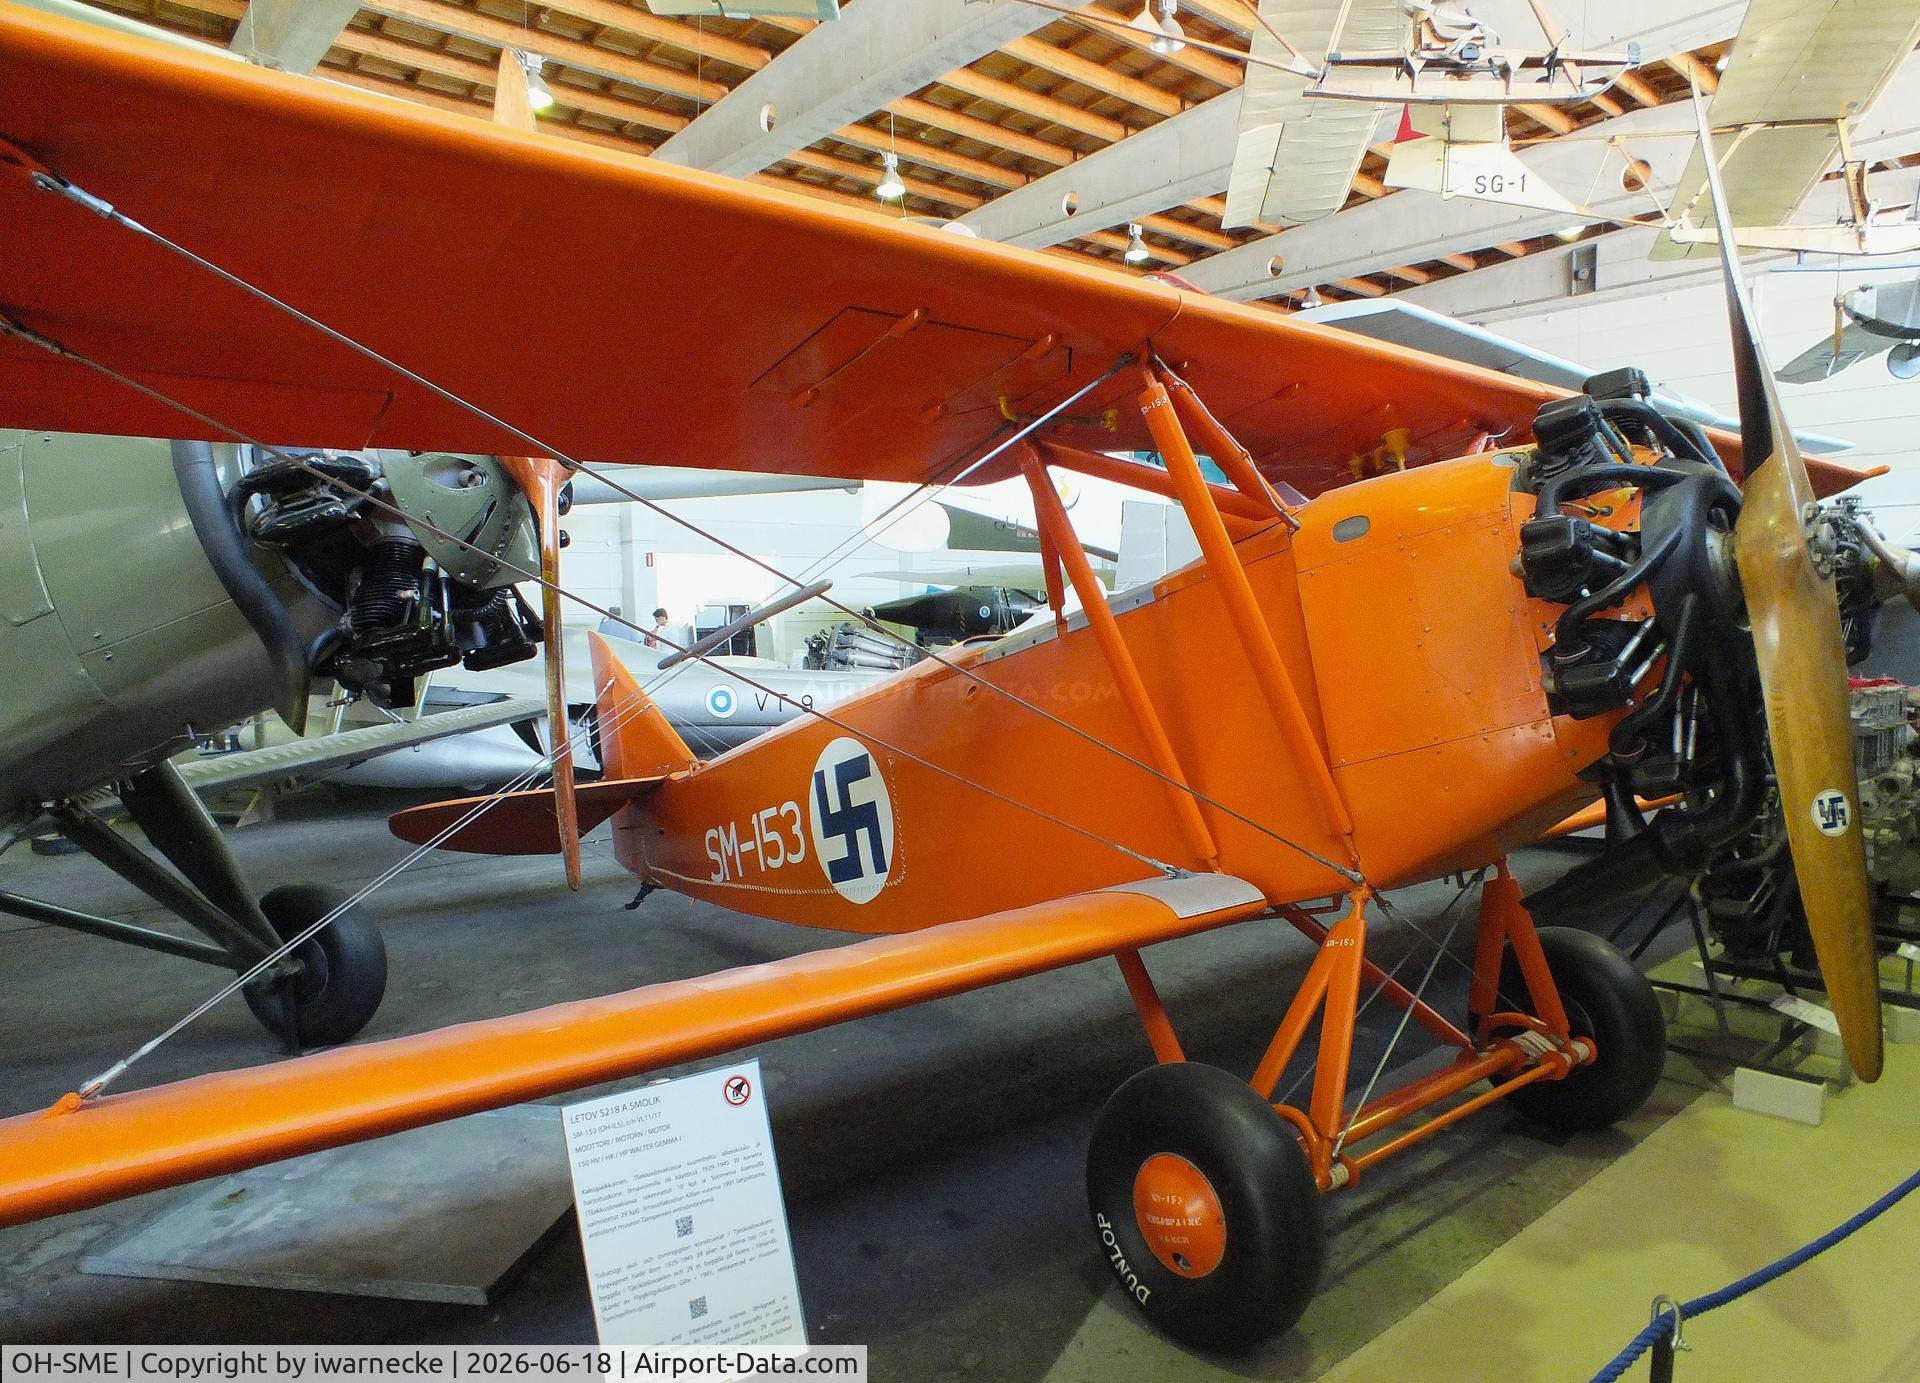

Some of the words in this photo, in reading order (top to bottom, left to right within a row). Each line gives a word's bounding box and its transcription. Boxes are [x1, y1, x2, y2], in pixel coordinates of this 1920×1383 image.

[1474, 174, 1526, 194] SG-1
[705, 801, 805, 883] SM-153
[570, 1110, 598, 1124] LETOV
[599, 1104, 620, 1117] S218
[621, 1103, 627, 1111] A
[629, 1095, 660, 1110] SMOLIK
[572, 1127, 597, 1139] SM-153
[574, 1138, 609, 1153] MOOTTORI
[615, 1130, 643, 1143] MOTORN
[648, 1123, 671, 1134] MOTOR
[577, 1159, 589, 1168] 150
[628, 1142, 653, 1154] WALTER
[1097, 1213, 1151, 1305] DUNLOP
